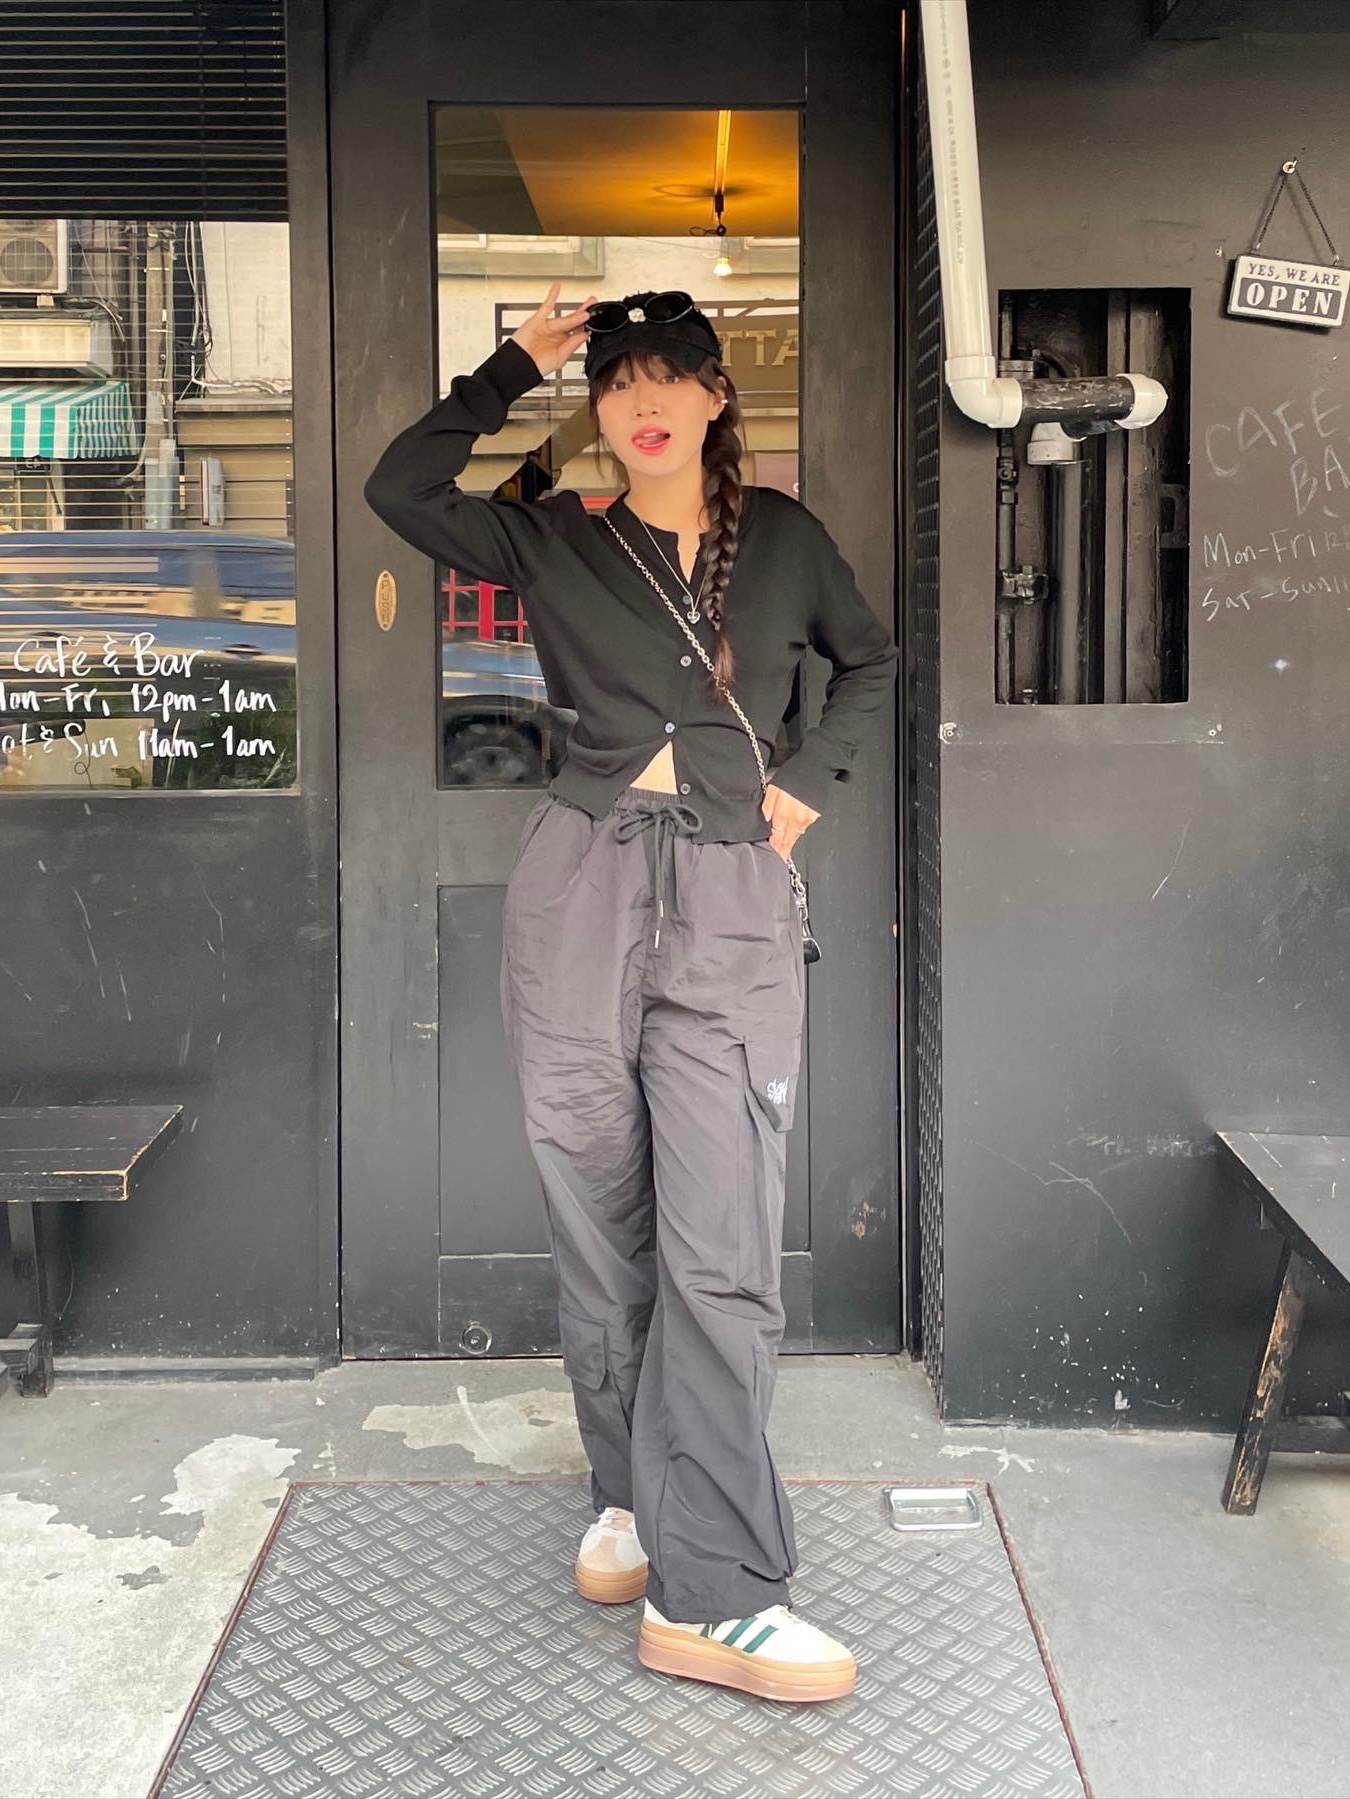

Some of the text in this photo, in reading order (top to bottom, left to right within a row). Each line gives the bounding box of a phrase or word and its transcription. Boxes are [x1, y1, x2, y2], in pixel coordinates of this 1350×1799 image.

[1249, 264, 1340, 286] YES, WE ARE
[1246, 283, 1333, 315] OPEN
[1205, 388, 1342, 477] CAFE
[1290, 445, 1350, 516] BA
[14, 632, 207, 678] Café & Bar
[0, 722, 34, 760] at
[63, 722, 118, 761] Sun
